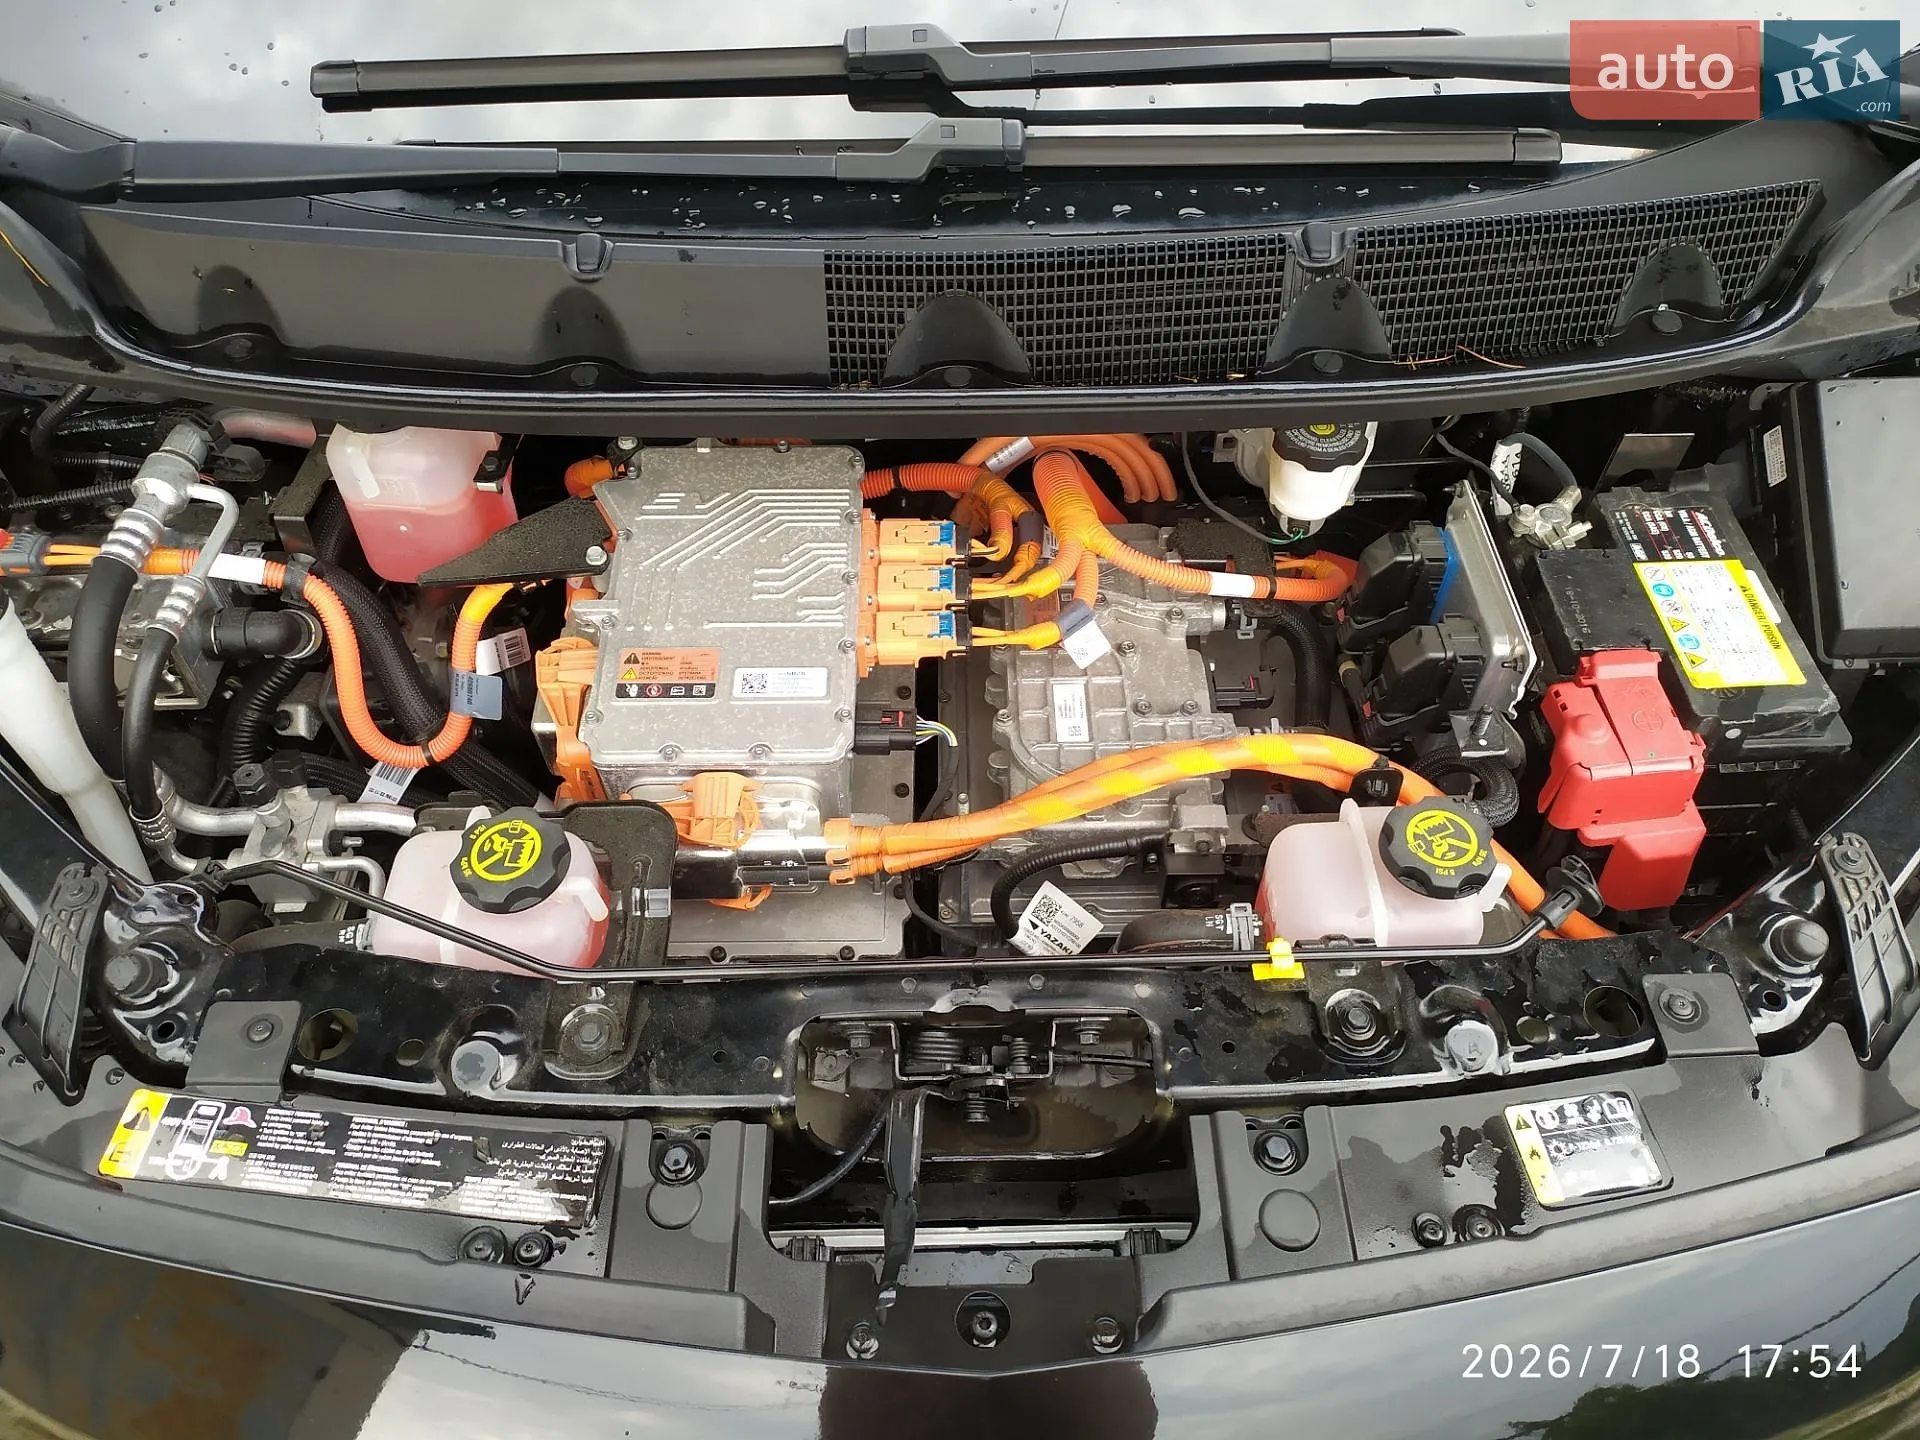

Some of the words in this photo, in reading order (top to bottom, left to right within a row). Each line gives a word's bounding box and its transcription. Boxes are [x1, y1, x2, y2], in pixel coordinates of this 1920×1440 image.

[1695, 511, 1725, 557] ACDelco
[1744, 594, 1766, 620] DANGER
[1761, 624, 1782, 650] POISON
[476, 824, 486, 835] PSI
[1435, 867, 1449, 876] PSI
[1215, 915, 1224, 931] SGT
[1040, 928, 1073, 955] YAZAKI
